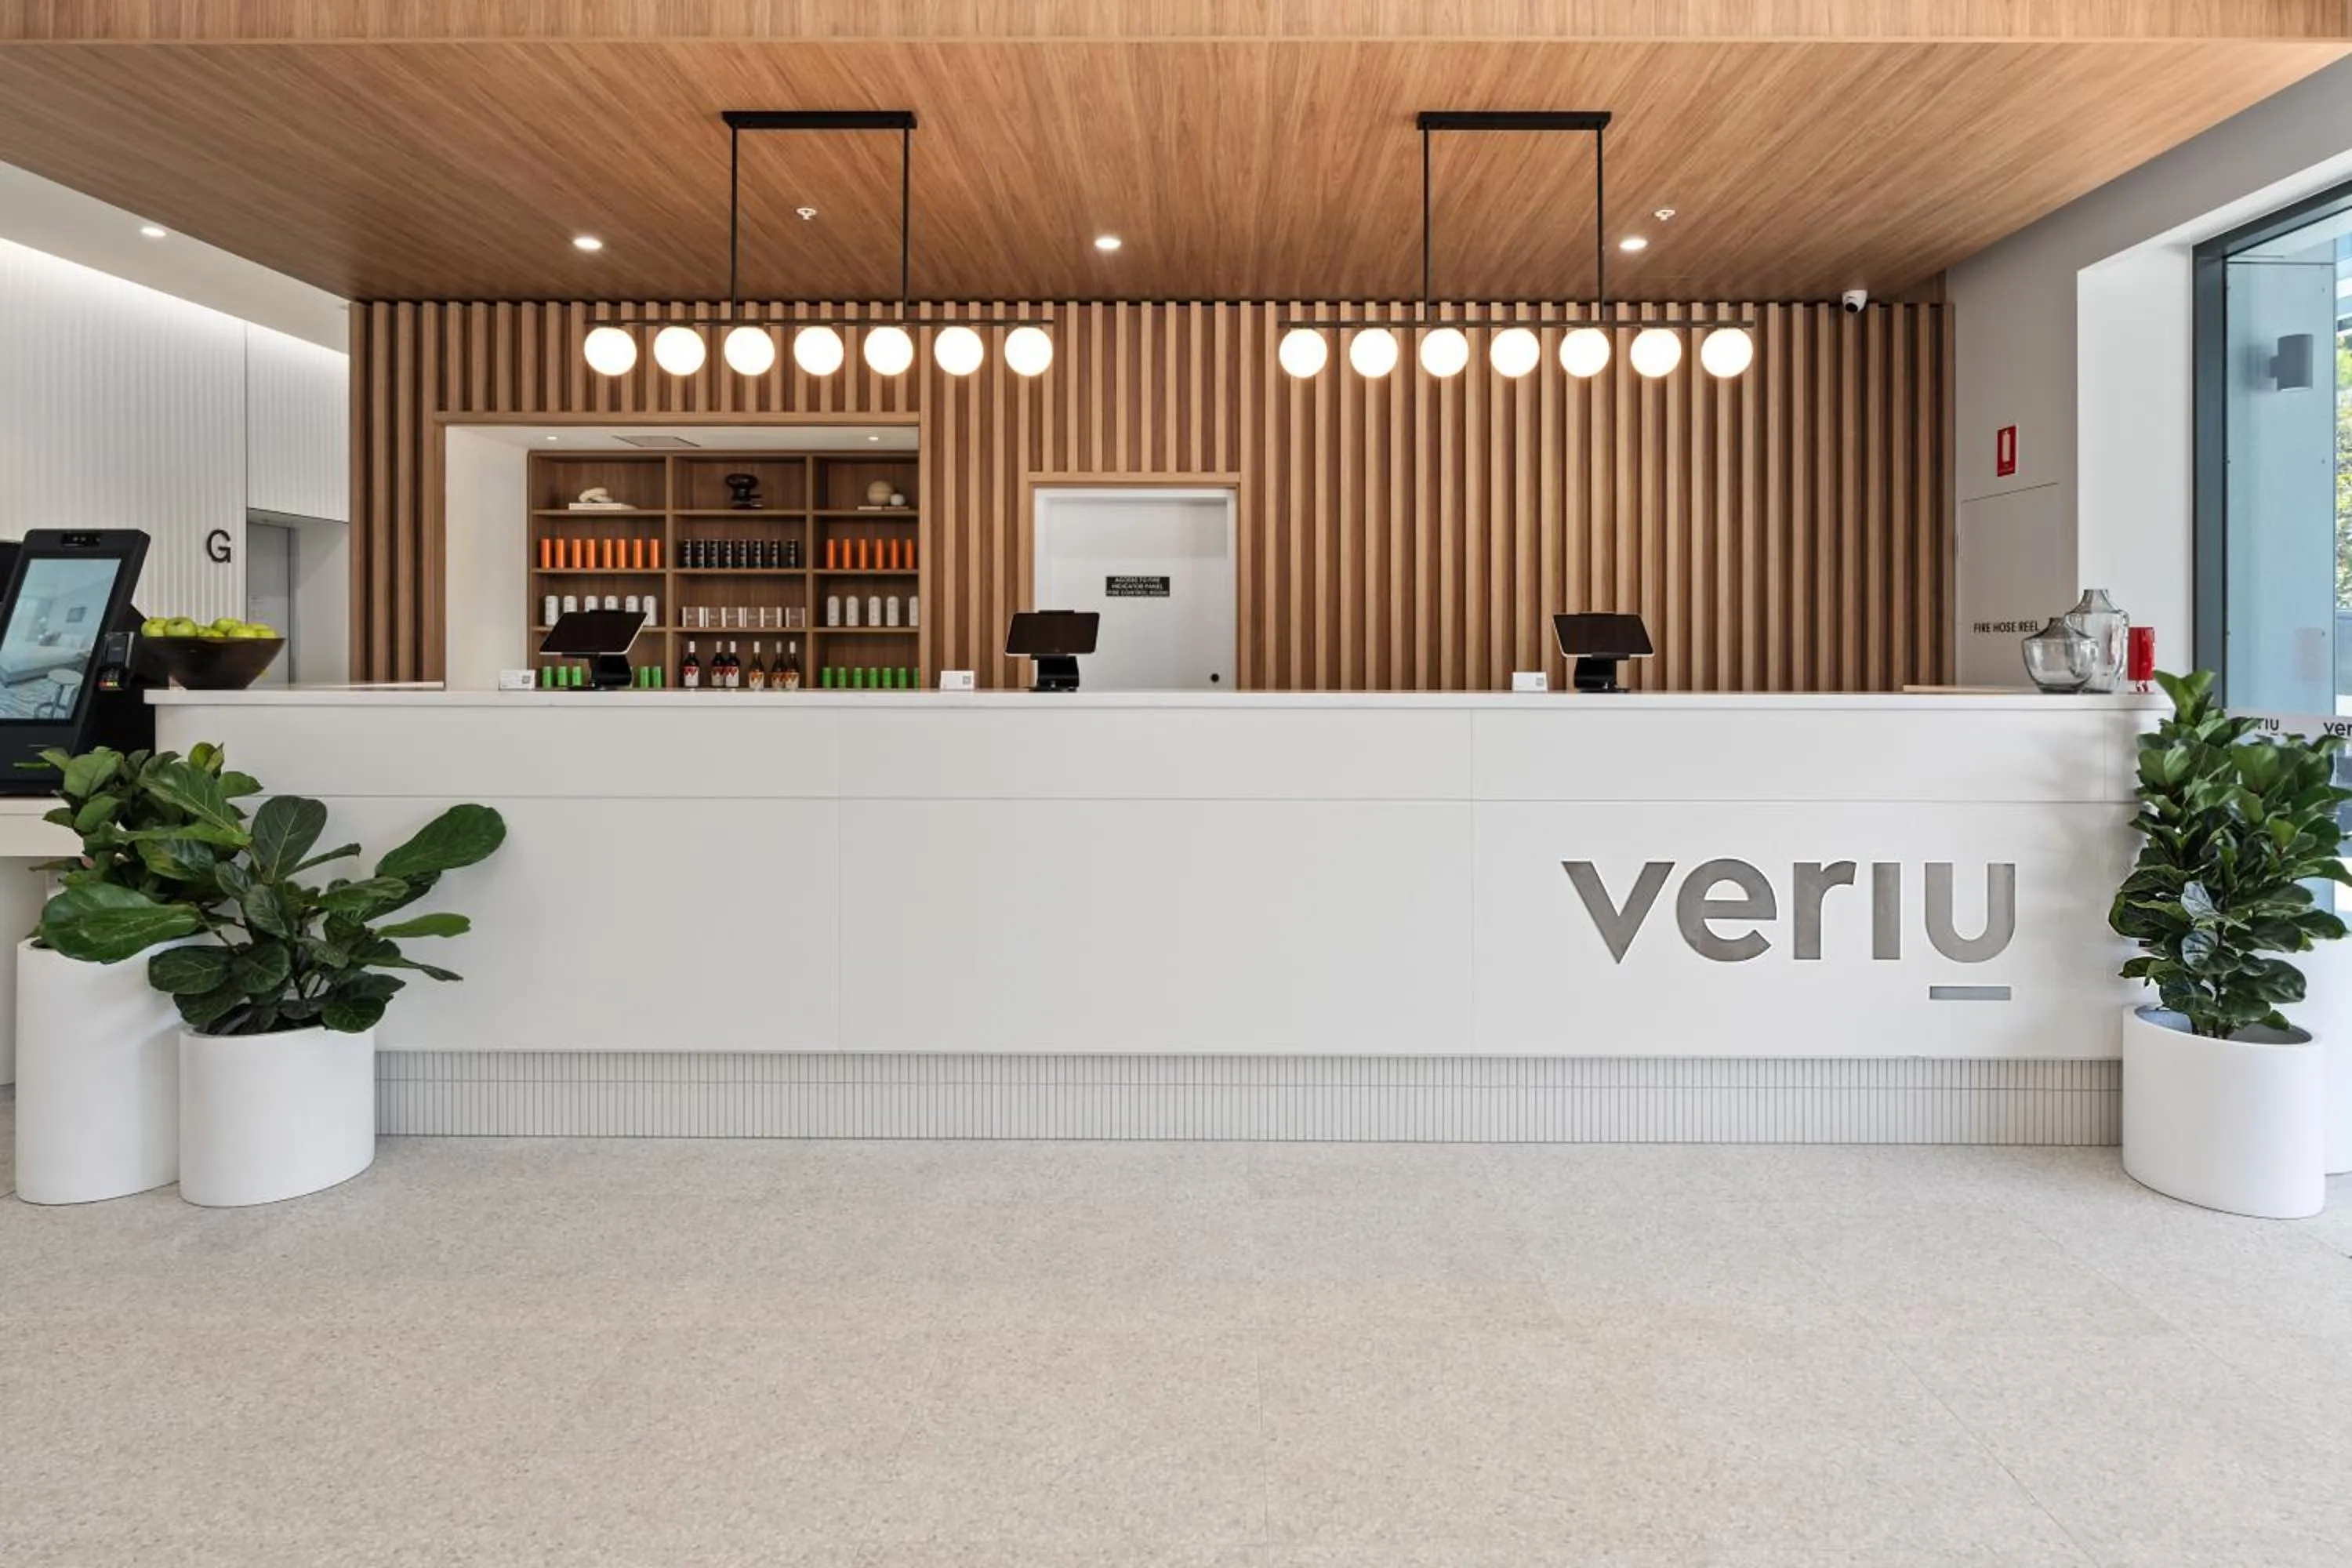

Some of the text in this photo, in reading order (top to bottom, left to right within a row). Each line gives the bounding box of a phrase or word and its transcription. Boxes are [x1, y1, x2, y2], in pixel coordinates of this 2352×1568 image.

[205, 528, 230, 563] G
[1973, 620, 2039, 633] FIRE HOSE REEL
[1560, 858, 2016, 1000] veriu
